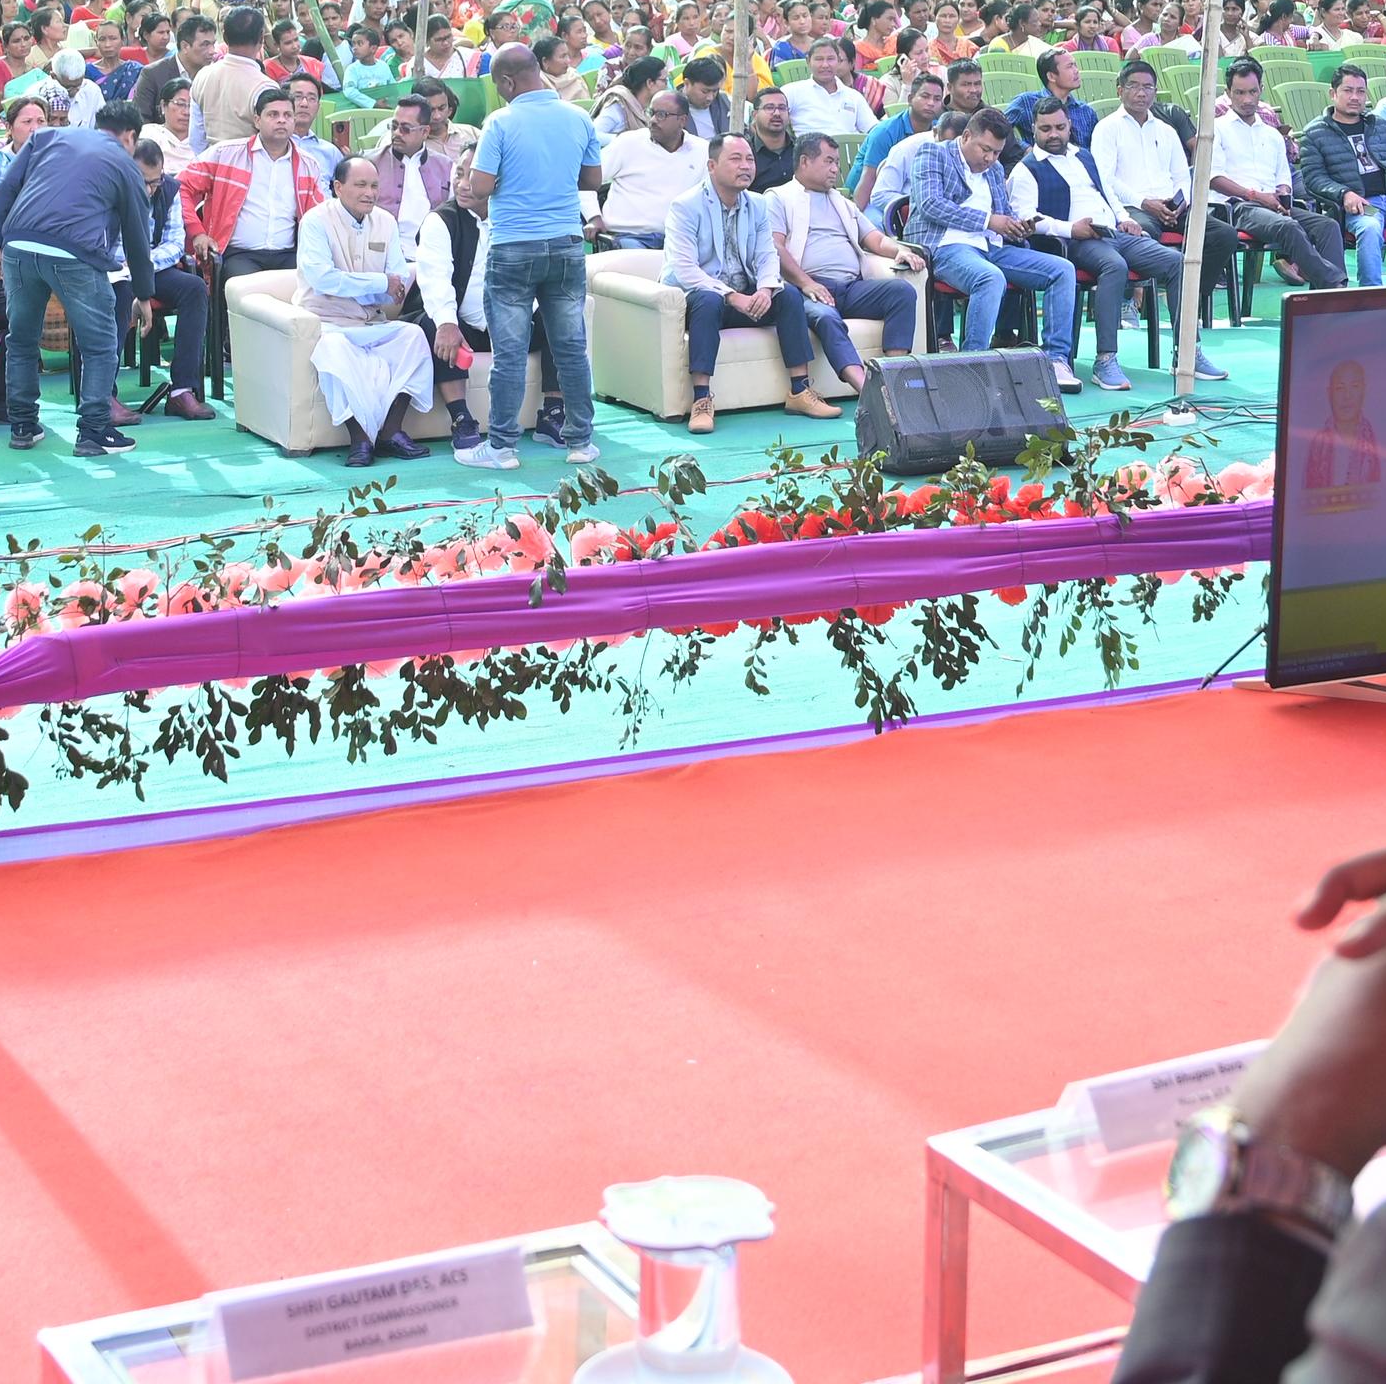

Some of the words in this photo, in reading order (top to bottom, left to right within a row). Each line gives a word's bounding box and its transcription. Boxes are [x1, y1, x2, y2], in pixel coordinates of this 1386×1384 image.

[285, 1298, 324, 1320] SHRI
[325, 1282, 398, 1310] GAUTAM
[438, 1267, 469, 1288] ACS
[304, 1316, 359, 1340] DISTRICT
